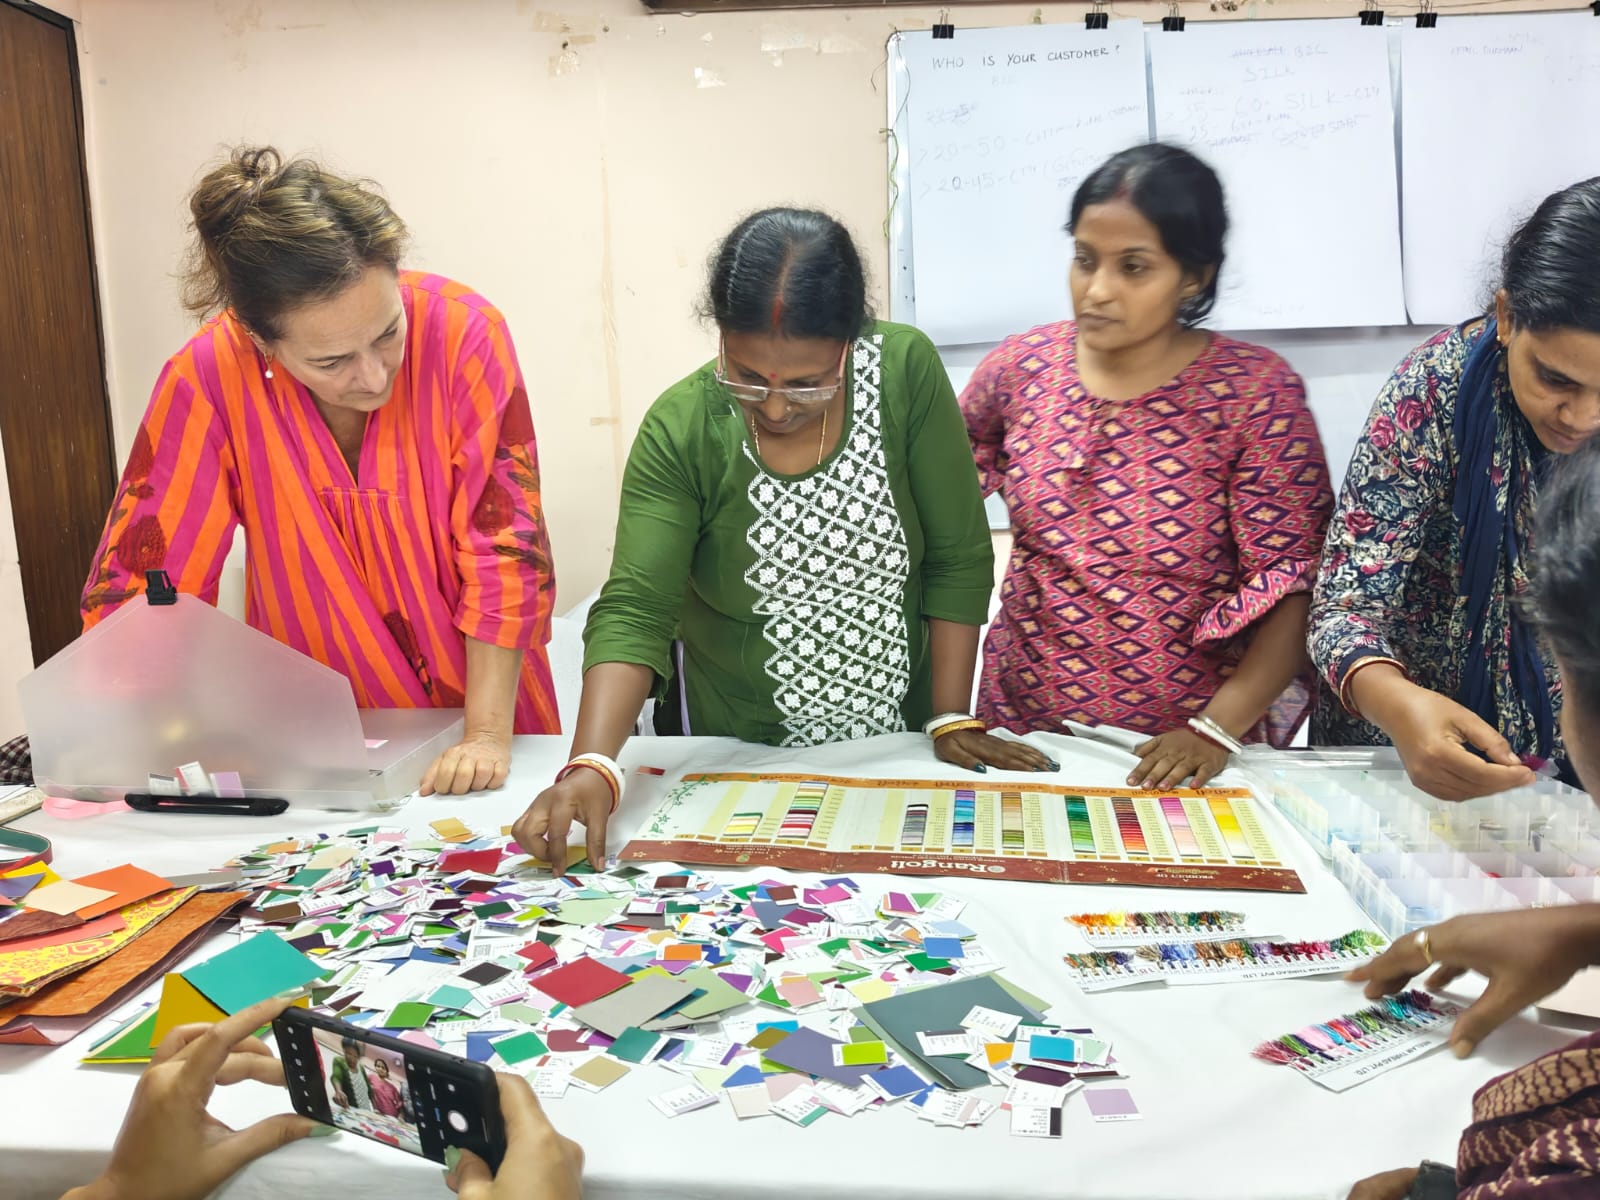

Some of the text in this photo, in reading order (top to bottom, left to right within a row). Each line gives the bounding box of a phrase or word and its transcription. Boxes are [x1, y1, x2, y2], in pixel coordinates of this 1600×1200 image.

[932, 57, 964, 69] WHO
[982, 56, 996, 67] IS
[1007, 52, 1036, 66] YOUR
[891, 859, 988, 873] Rangoli
